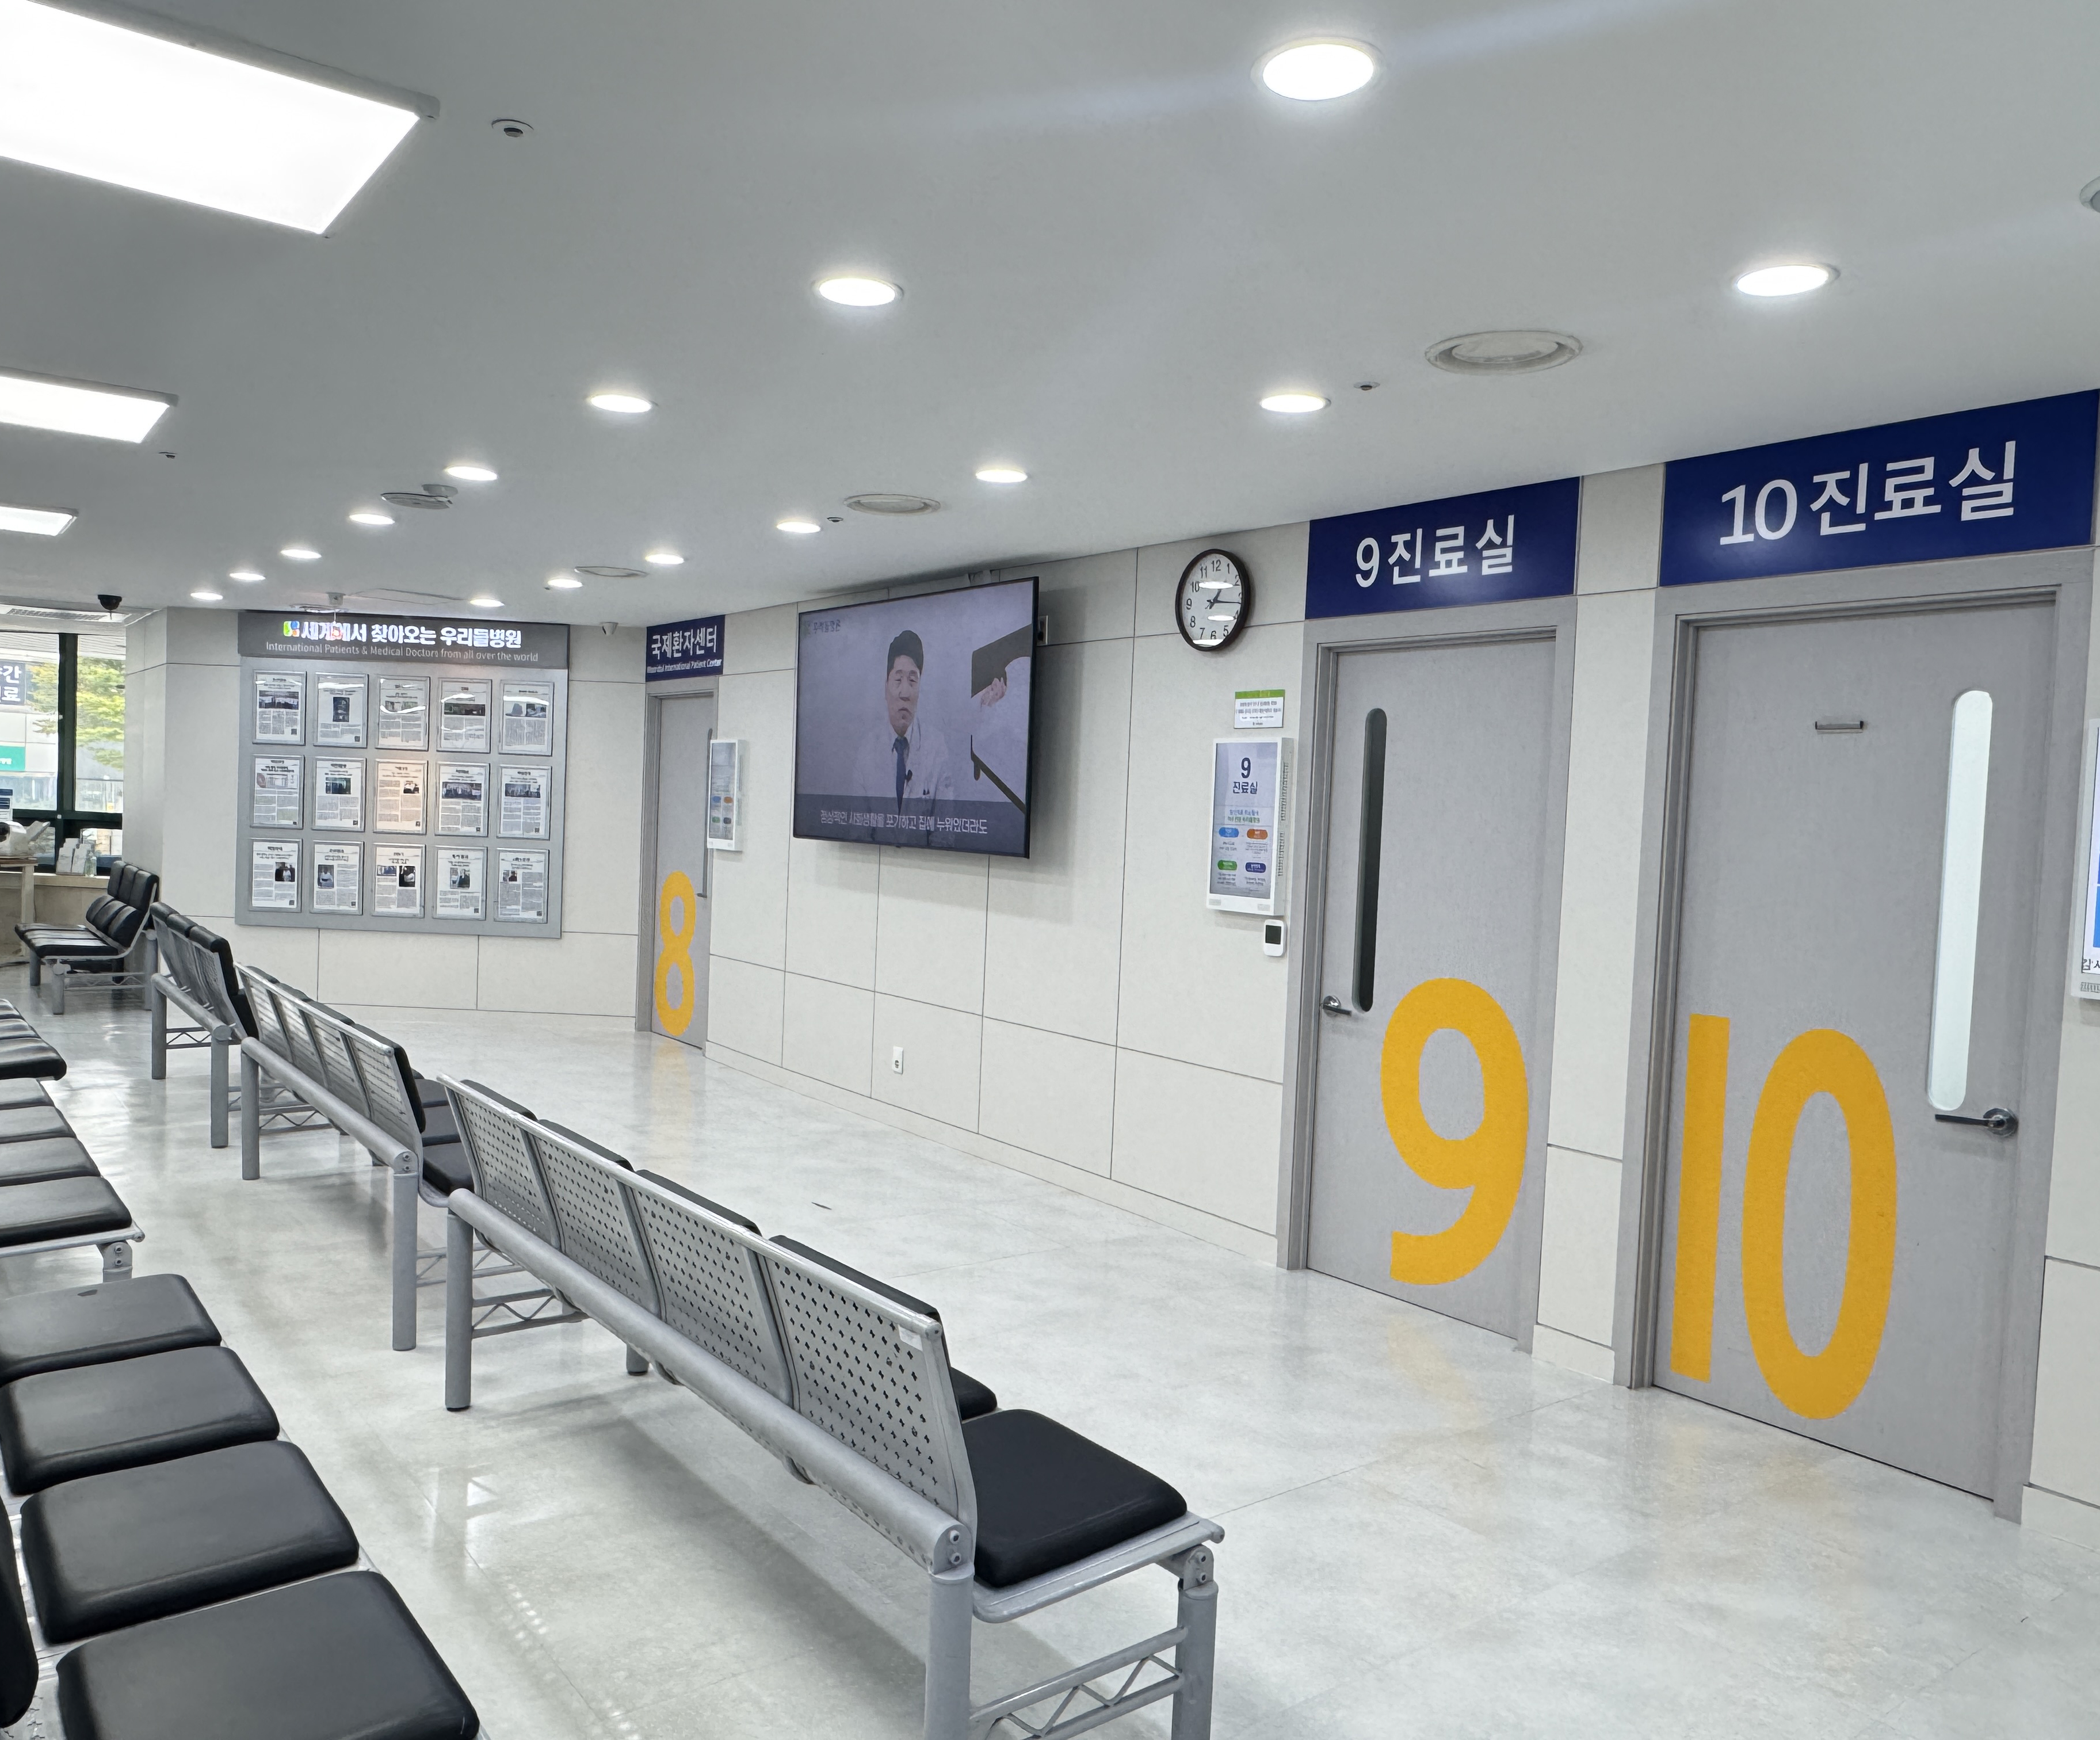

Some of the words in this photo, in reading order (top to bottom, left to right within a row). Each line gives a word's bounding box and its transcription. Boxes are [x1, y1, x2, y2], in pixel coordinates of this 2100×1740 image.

[1200, 564, 1208, 578] 11
[1211, 559, 1221, 572] 12
[1227, 563, 1231, 574] 1
[1191, 581, 1200, 593] 10
[1186, 598, 1193, 610] 9
[1190, 616, 1196, 628] 8
[301, 621, 367, 641] 세계에서
[371, 623, 437, 645] 찾아오는
[440, 627, 522, 648] 우리들병원
[1200, 627, 1205, 640] 7
[1223, 625, 1229, 637] 5
[651, 625, 717, 660] 국제환자센터
[266, 642, 322, 654] International
[324, 644, 360, 655] Patients
[361, 646, 368, 655] &
[371, 646, 403, 657] Medical
[406, 647, 438, 658] Doctors
[441, 648, 461, 659] from
[463, 650, 474, 660] all
[476, 652, 495, 660] over
[497, 652, 511, 661] the
[514, 651, 539, 662] world
[0, 665, 22, 684] 간
[0, 685, 21, 702] 료
[1241, 757, 1251, 779] 9
[1233, 780, 1258, 795] 진료실
[654, 871, 696, 1036] 8
[1381, 978, 1529, 1285] 9
[1670, 1014, 1897, 1420] 10
